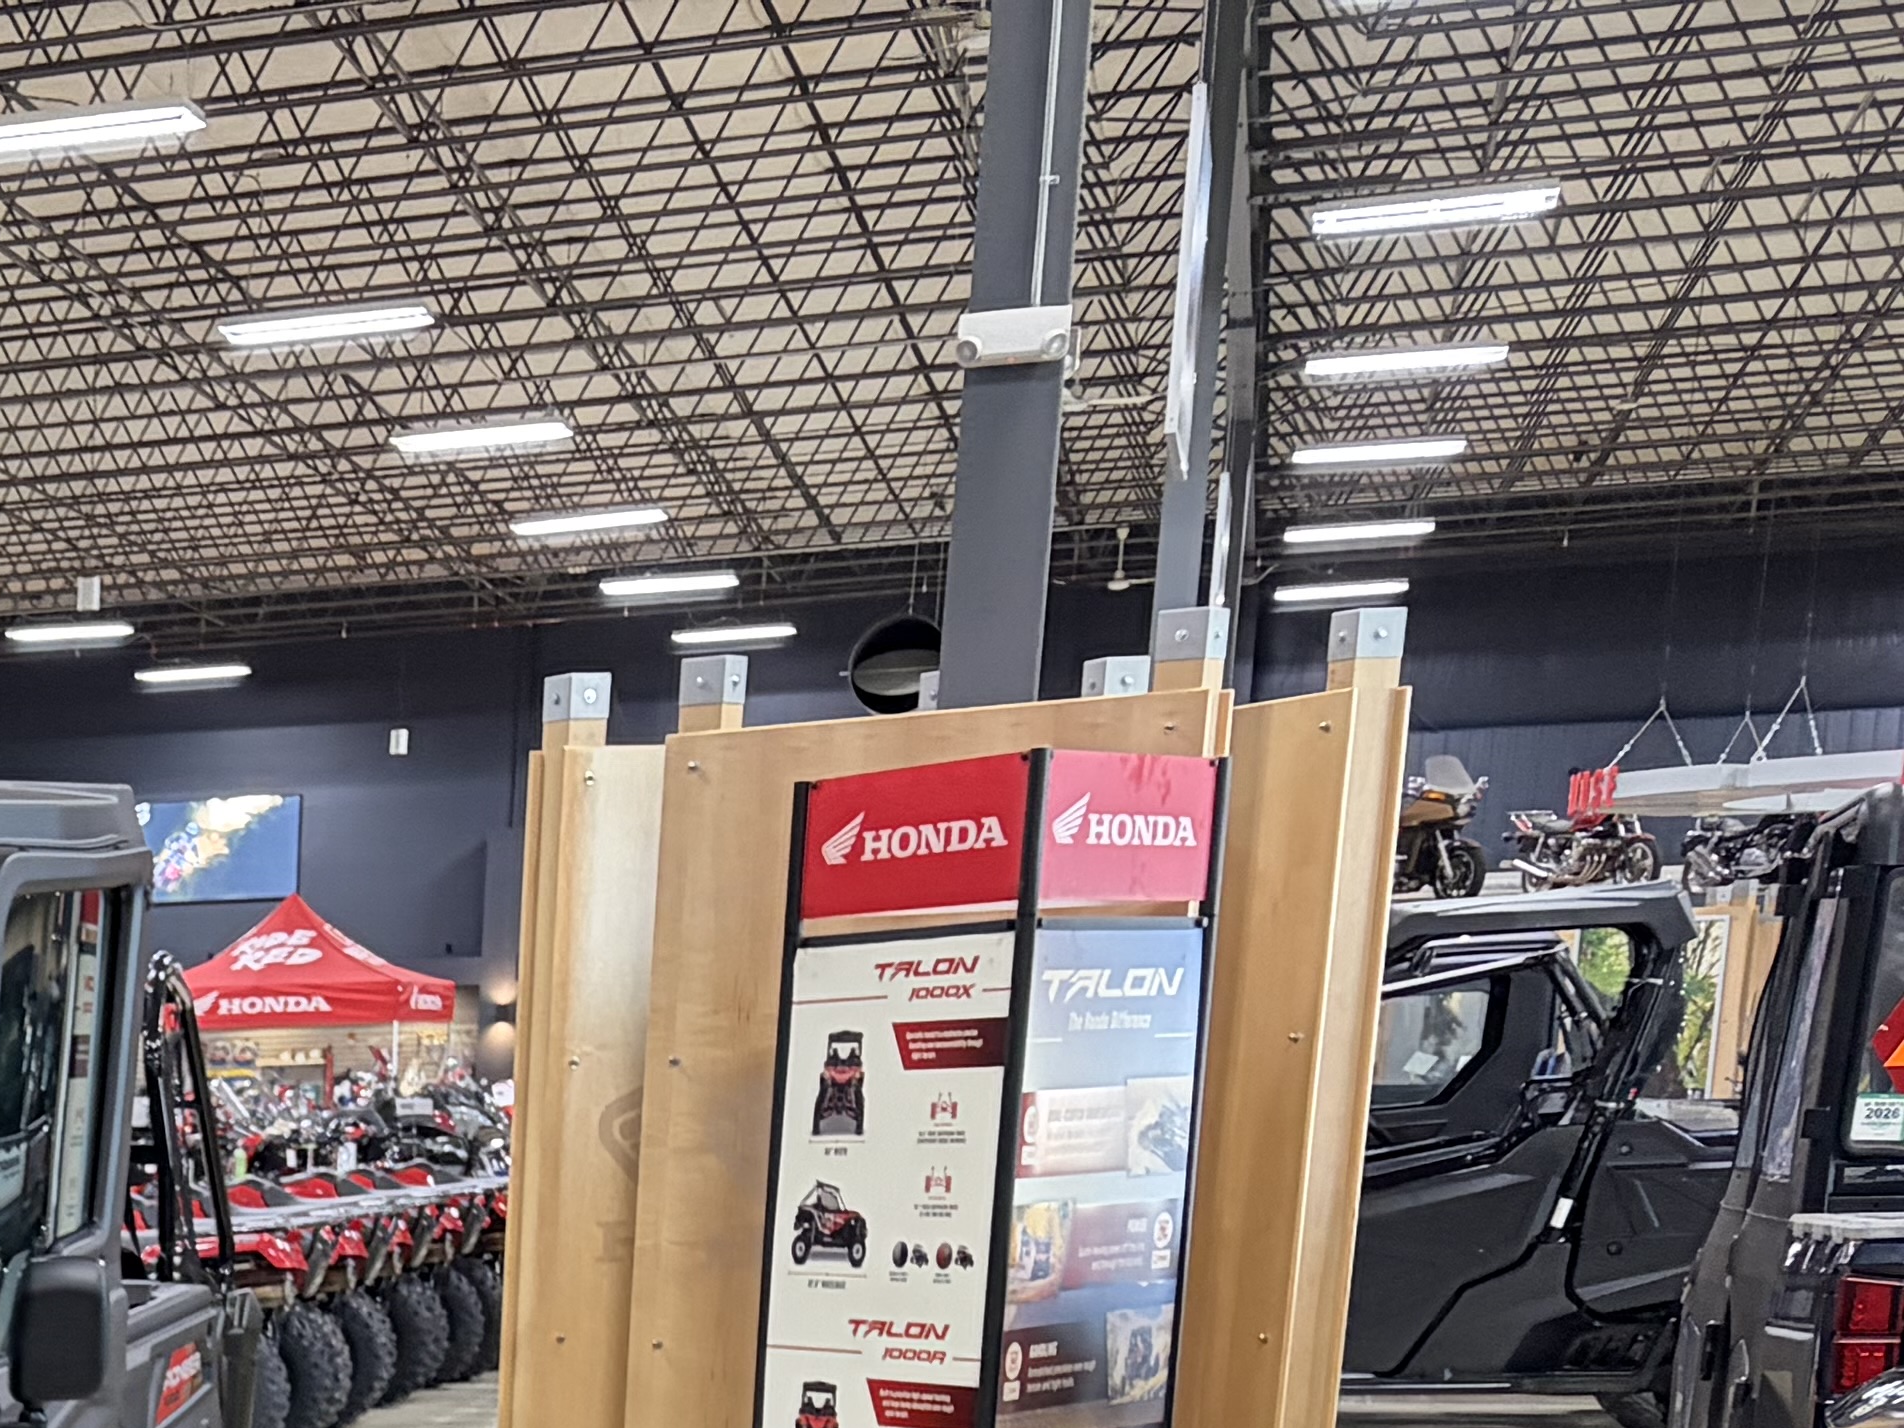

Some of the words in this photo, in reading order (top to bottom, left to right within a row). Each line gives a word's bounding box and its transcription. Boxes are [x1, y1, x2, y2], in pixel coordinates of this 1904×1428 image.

[861, 816, 1008, 861] HONDA
[1086, 812, 1197, 847] HONDA
[230, 948, 323, 971] RED
[874, 955, 980, 981] TALON
[908, 983, 976, 1002] 1000X
[1042, 967, 1185, 1003] TALON
[218, 996, 332, 1015] HONDA
[848, 1318, 950, 1341] TALON
[882, 1347, 946, 1365] 1000R
